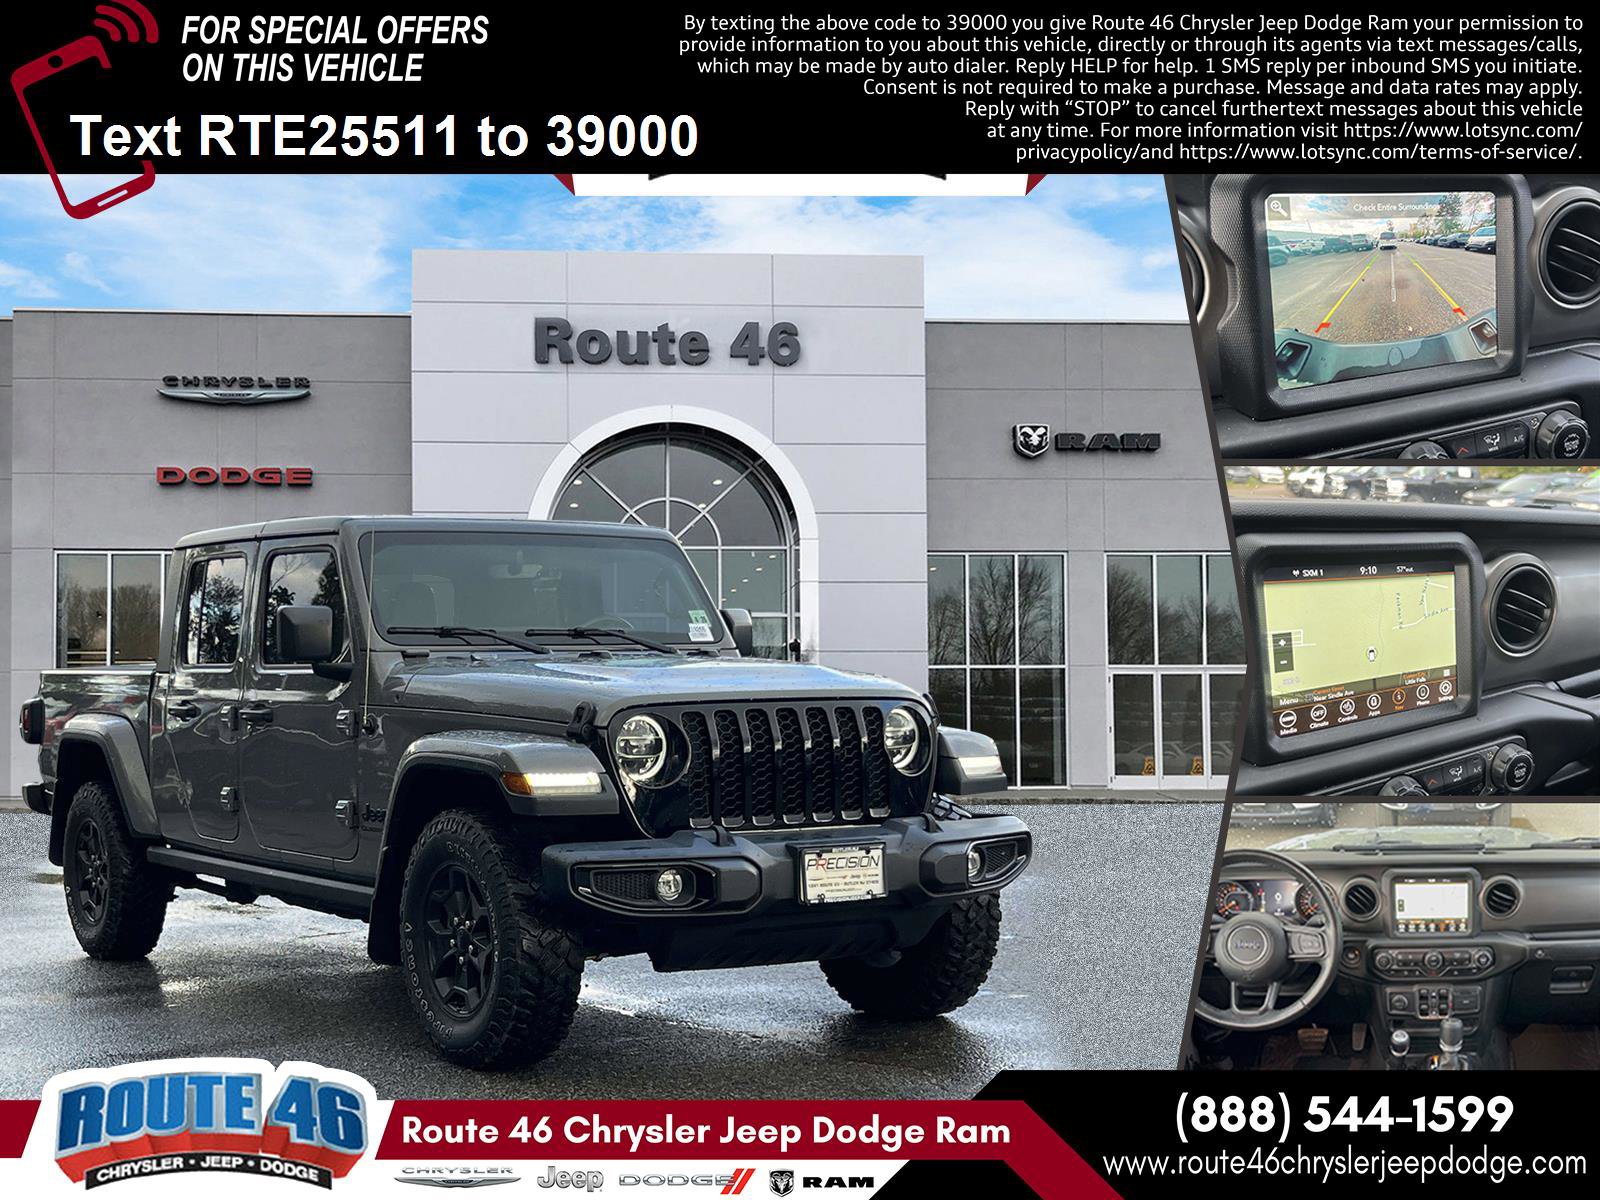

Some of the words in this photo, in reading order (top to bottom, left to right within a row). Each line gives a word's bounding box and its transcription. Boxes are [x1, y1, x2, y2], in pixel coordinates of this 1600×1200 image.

[1353, 203, 1376, 211] Check
[1377, 203, 1397, 211] Entire
[534, 317, 710, 366] Route
[730, 321, 802, 367] 46
[162, 375, 311, 388] CHRYSLER
[1055, 433, 1161, 452] RAM
[156, 466, 313, 486] DODGE
[1302, 569, 1318, 577] SXM
[1360, 566, 1377, 575] 9:10
[807, 855, 880, 871] PRECISION
